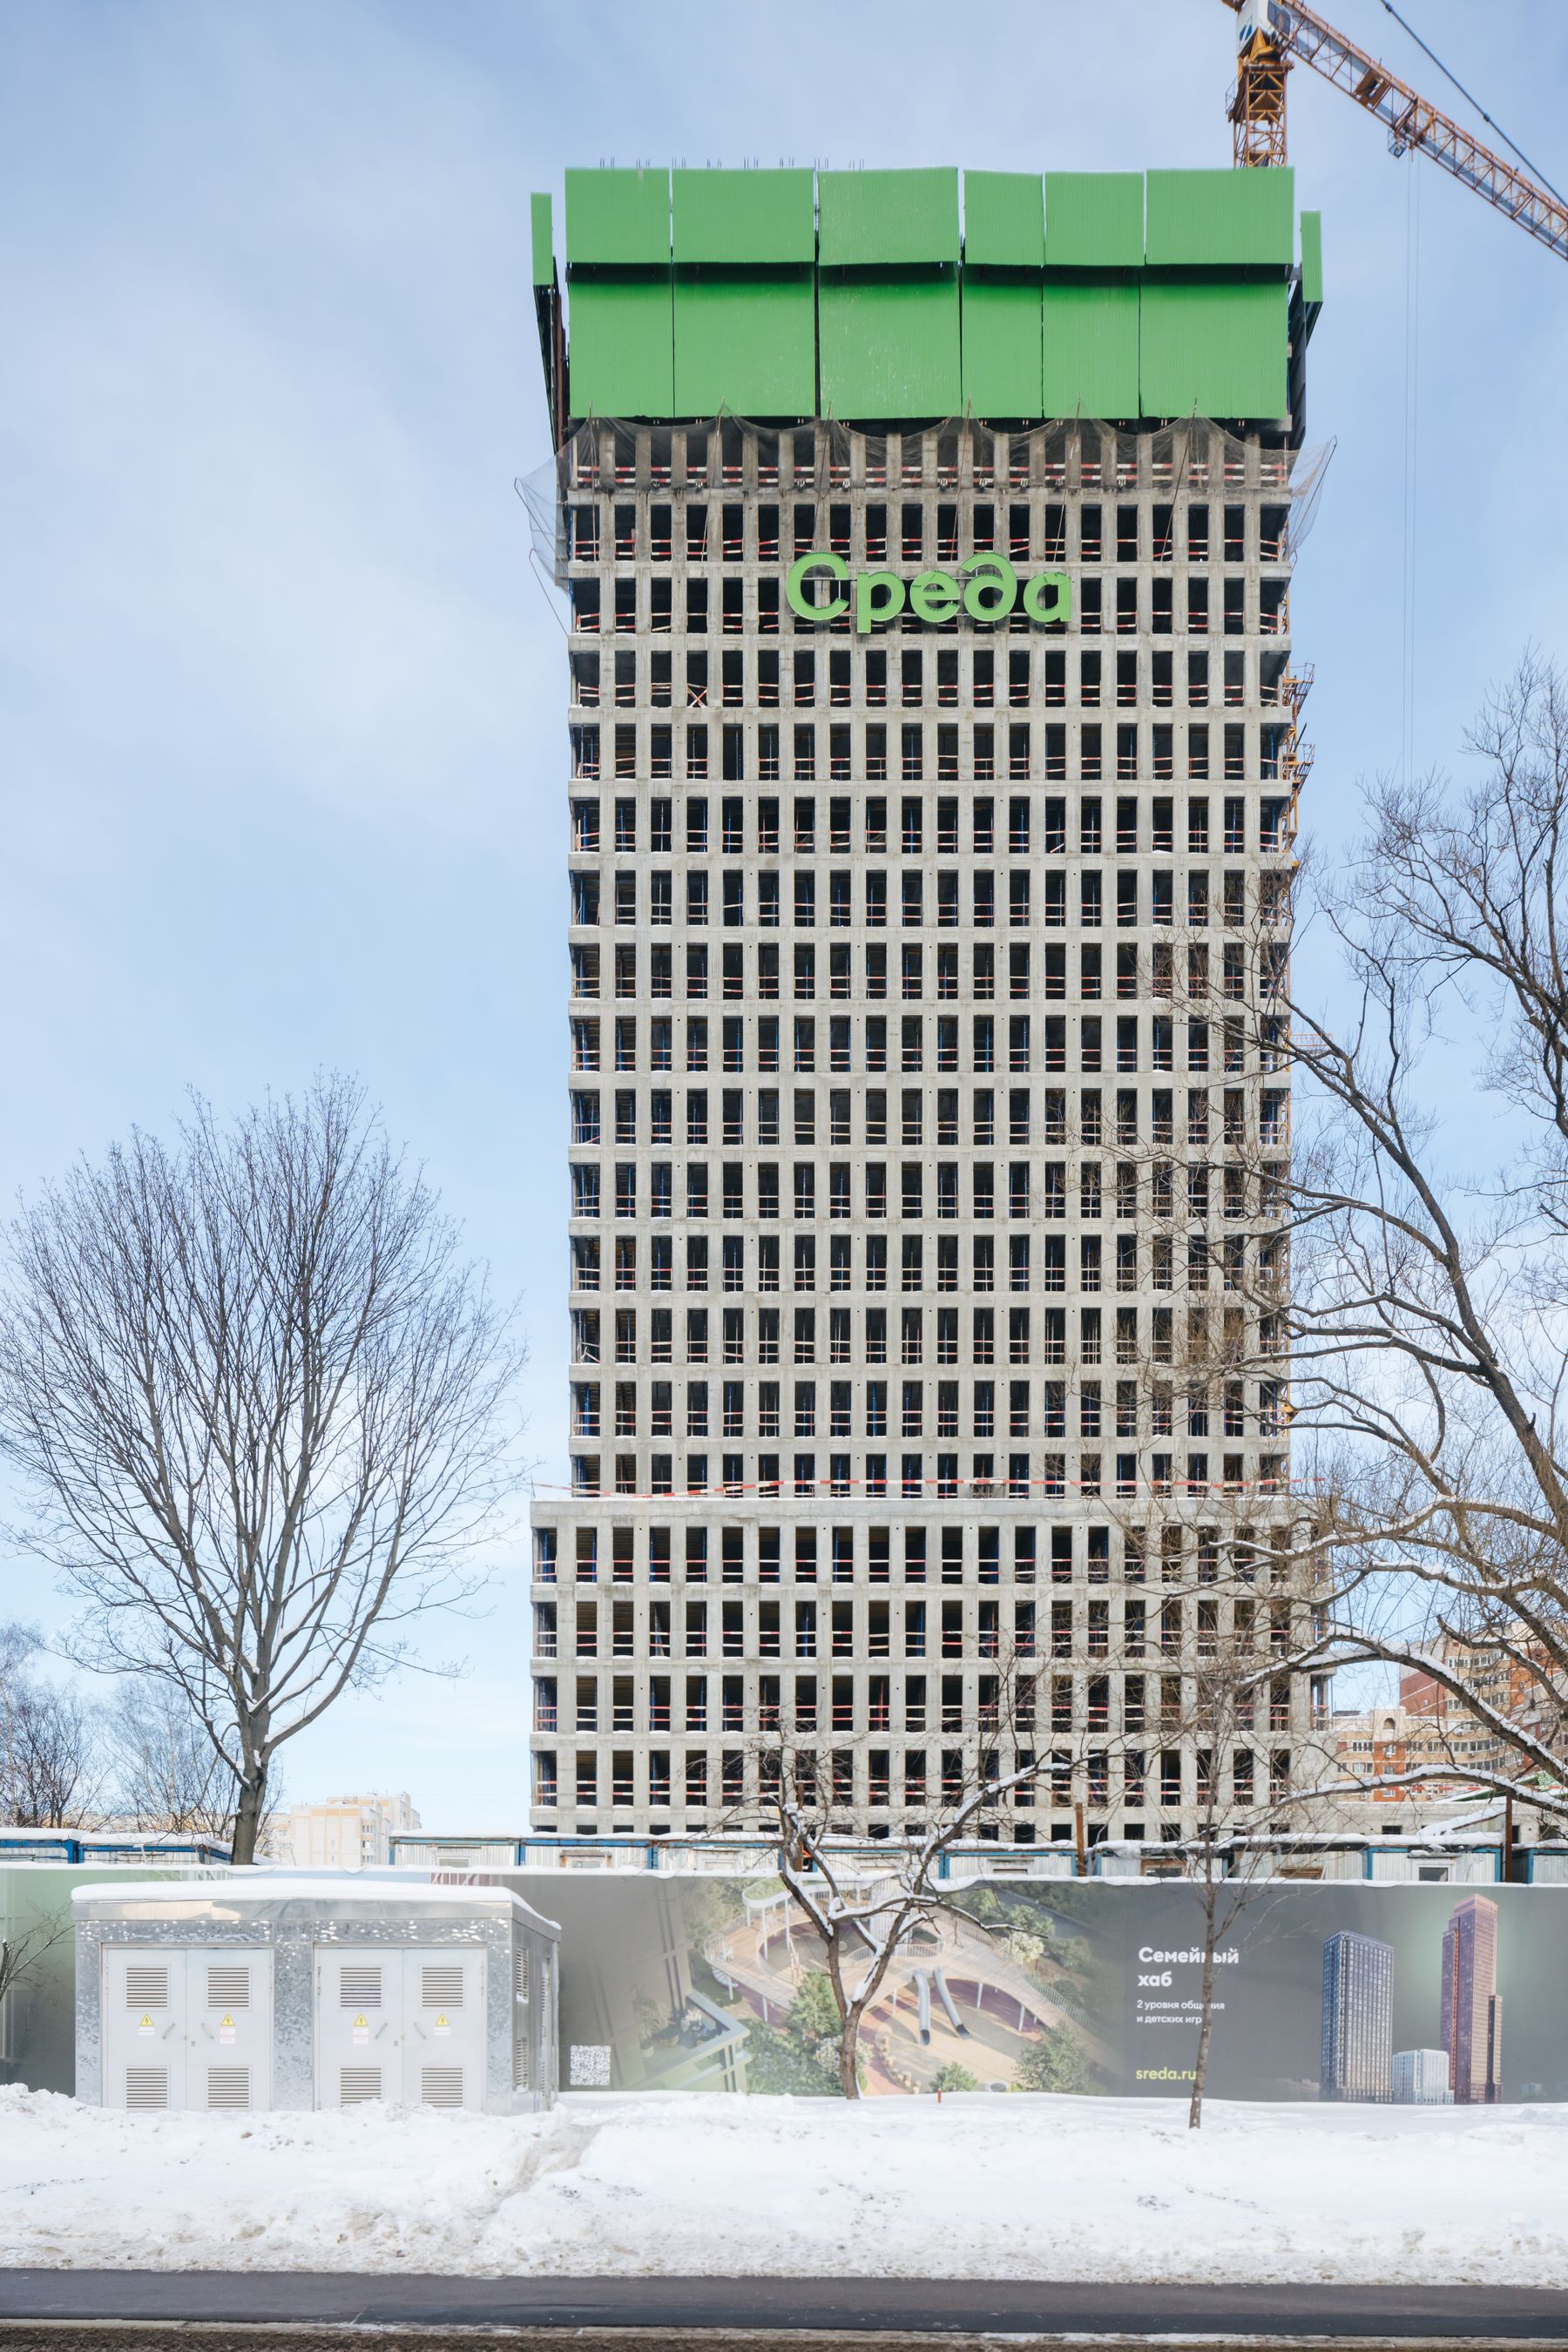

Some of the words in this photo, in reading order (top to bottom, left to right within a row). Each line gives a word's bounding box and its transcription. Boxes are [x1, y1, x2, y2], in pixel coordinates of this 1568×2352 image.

[786, 551, 1071, 633] Среда
[1138, 1971, 1173, 1987] хаб
[1137, 2000, 1143, 2009] 2
[1145, 2001, 1179, 2010] уровня
[1181, 2000, 1225, 2010] общия
[1136, 2067, 1196, 2080] sreda.ru
